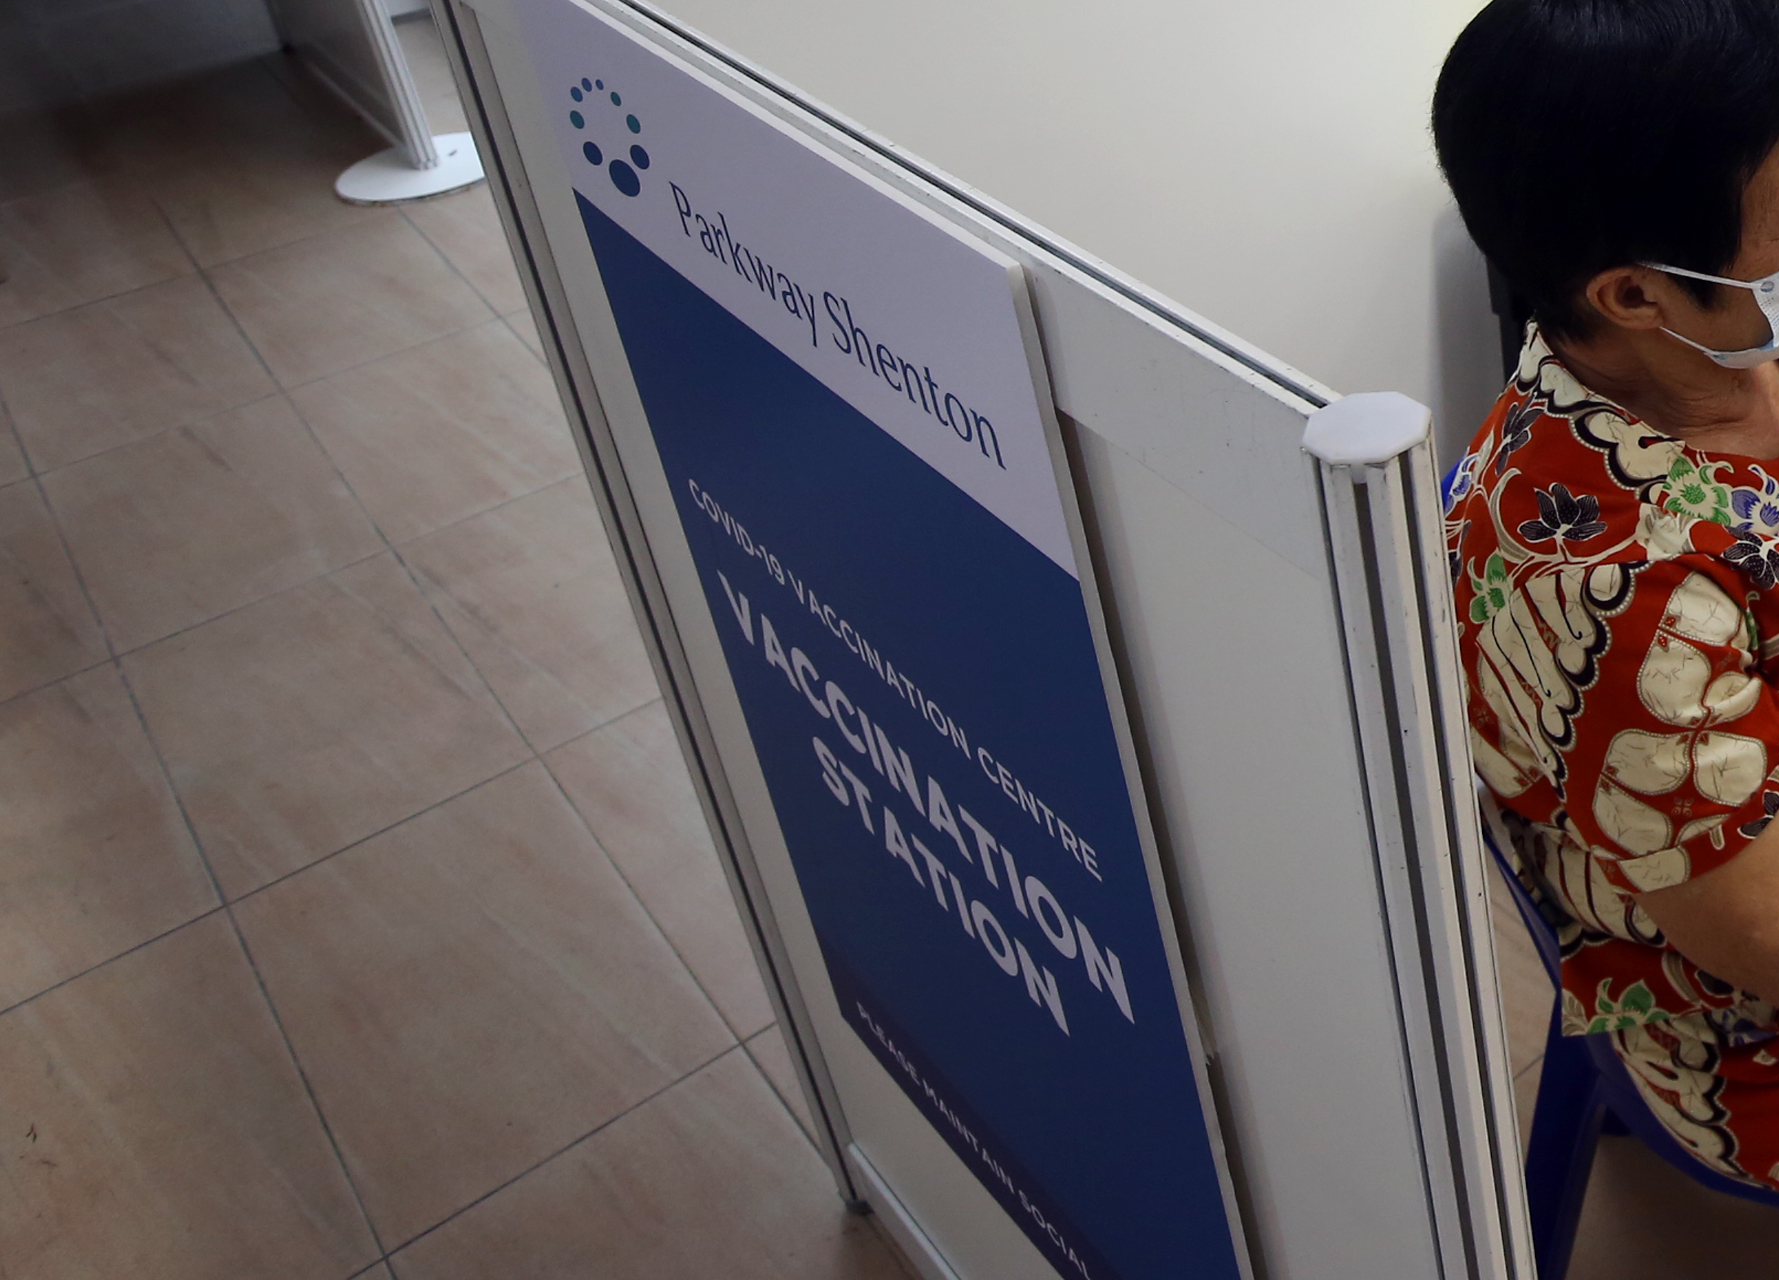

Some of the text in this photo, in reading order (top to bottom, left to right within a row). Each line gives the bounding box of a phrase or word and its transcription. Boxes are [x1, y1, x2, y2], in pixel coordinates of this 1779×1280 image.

[668, 180, 1007, 470] Parkway Shenton
[689, 479, 1103, 882] COVID-19 VACCINATION CENTRE
[717, 569, 1135, 1024] VACCINATION
[813, 736, 1070, 1037] STATION
[857, 1001, 921, 1087] PLEASE
[922, 1078, 1015, 1195] MAINTAIN
